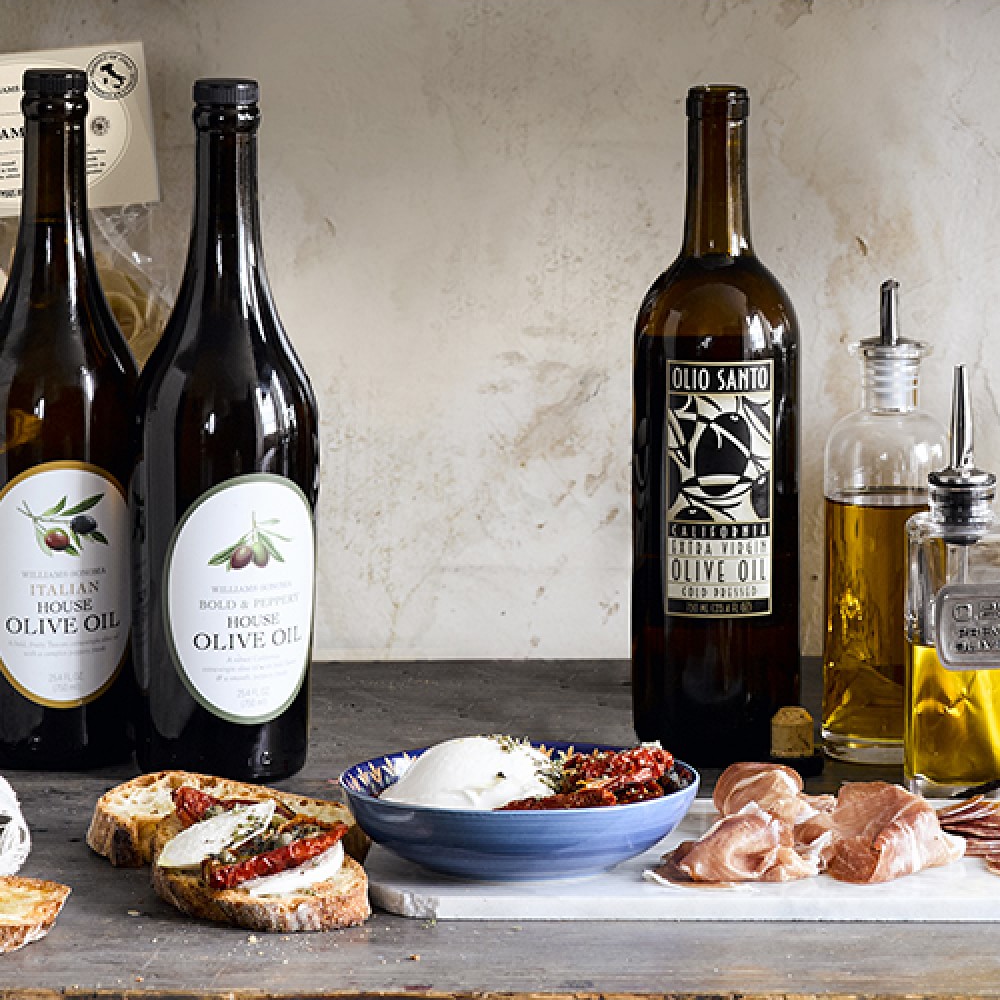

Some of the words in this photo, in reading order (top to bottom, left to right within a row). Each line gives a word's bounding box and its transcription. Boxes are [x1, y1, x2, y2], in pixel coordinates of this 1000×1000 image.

[671, 366, 711, 391] OLIO
[717, 365, 769, 392] SANTO
[671, 522, 767, 538] CALIFORNIA
[671, 539, 713, 556] EXTRA
[721, 539, 768, 556] VIRGIN
[671, 557, 726, 583] OLIVE
[737, 557, 767, 583] OIL
[30, 580, 100, 597] ITALIAN
[681, 585, 709, 598] COLD
[713, 585, 758, 598] PRESSED
[37, 597, 93, 614] HOUSE
[198, 598, 237, 611] BOLD
[240, 600, 249, 609] &
[253, 592, 300, 609] PEPPERY
[5, 615, 79, 635] OLIVE
[84, 611, 121, 633] OIL
[226, 612, 280, 629] HOUSE
[192, 631, 266, 651] OLIVE
[272, 625, 303, 647] OIL
